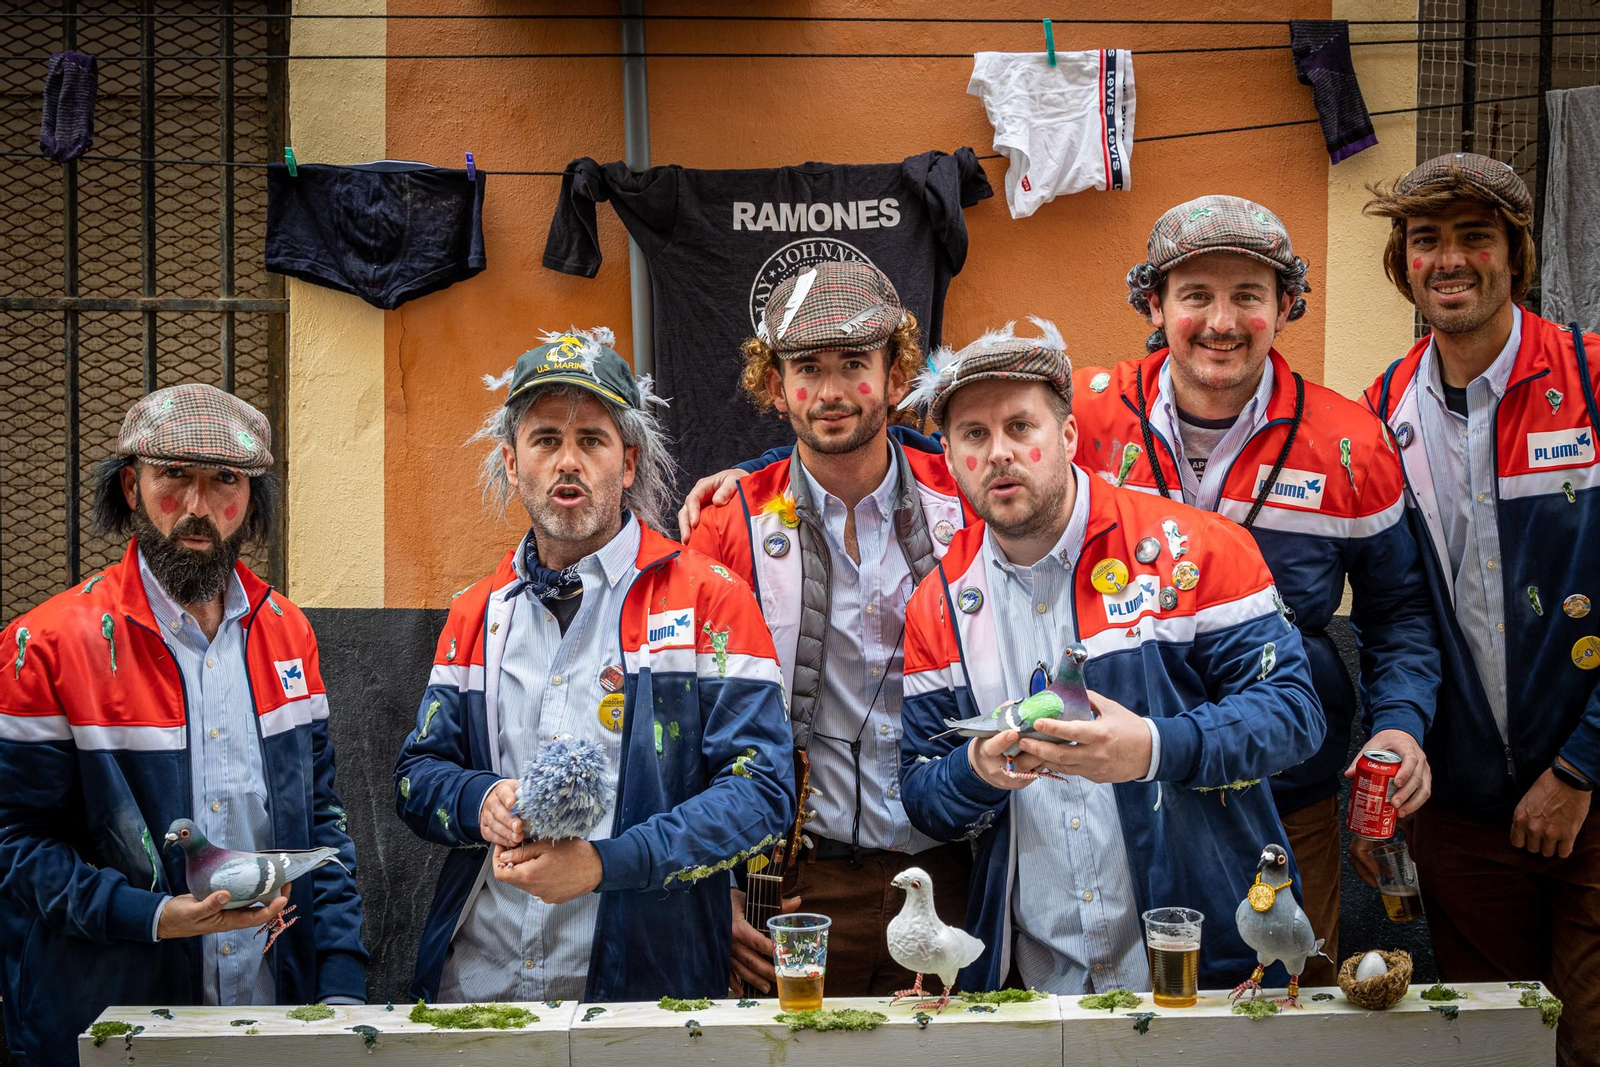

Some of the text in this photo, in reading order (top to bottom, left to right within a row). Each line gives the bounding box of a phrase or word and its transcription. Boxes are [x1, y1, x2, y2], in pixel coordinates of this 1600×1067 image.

[732, 198, 901, 232] RAMONES
[536, 362, 584, 373] U.S. MARIN
[1534, 443, 1579, 461] PLUMA
[649, 625, 675, 642] UMA
